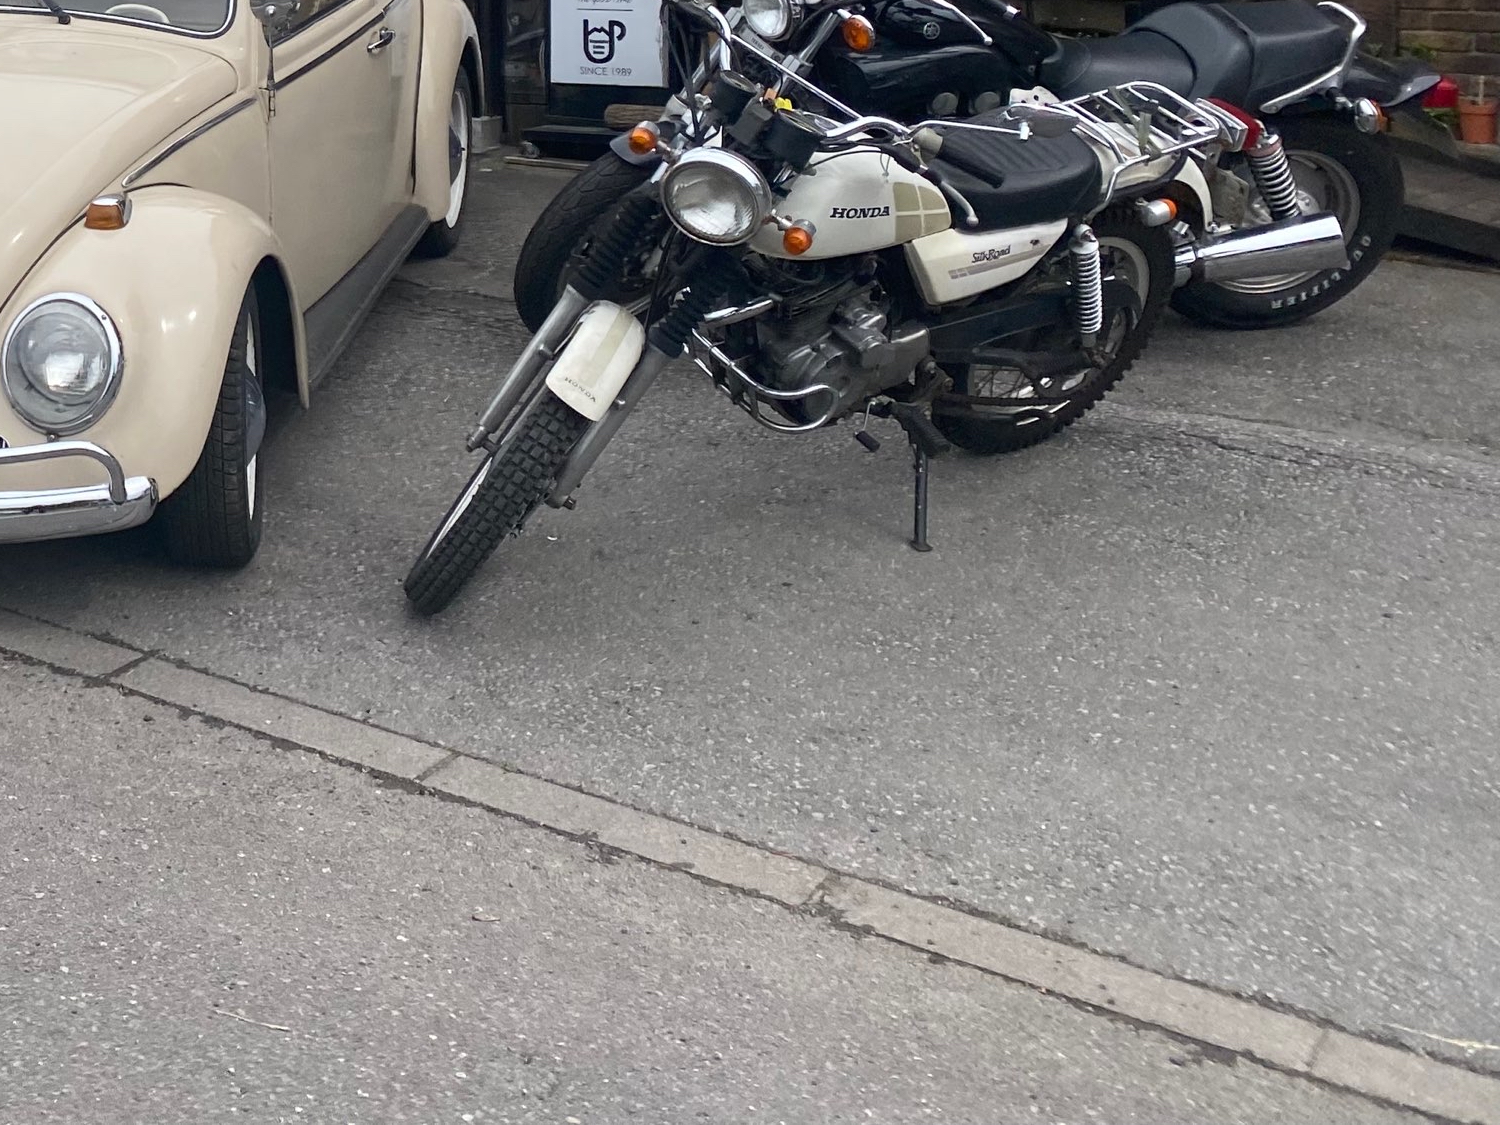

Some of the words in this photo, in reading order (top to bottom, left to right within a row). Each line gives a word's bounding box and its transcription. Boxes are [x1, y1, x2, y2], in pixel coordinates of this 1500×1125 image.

[580, 67, 608, 75] SINCE
[611, 68, 632, 76] 1989
[830, 206, 890, 218] HONDA
